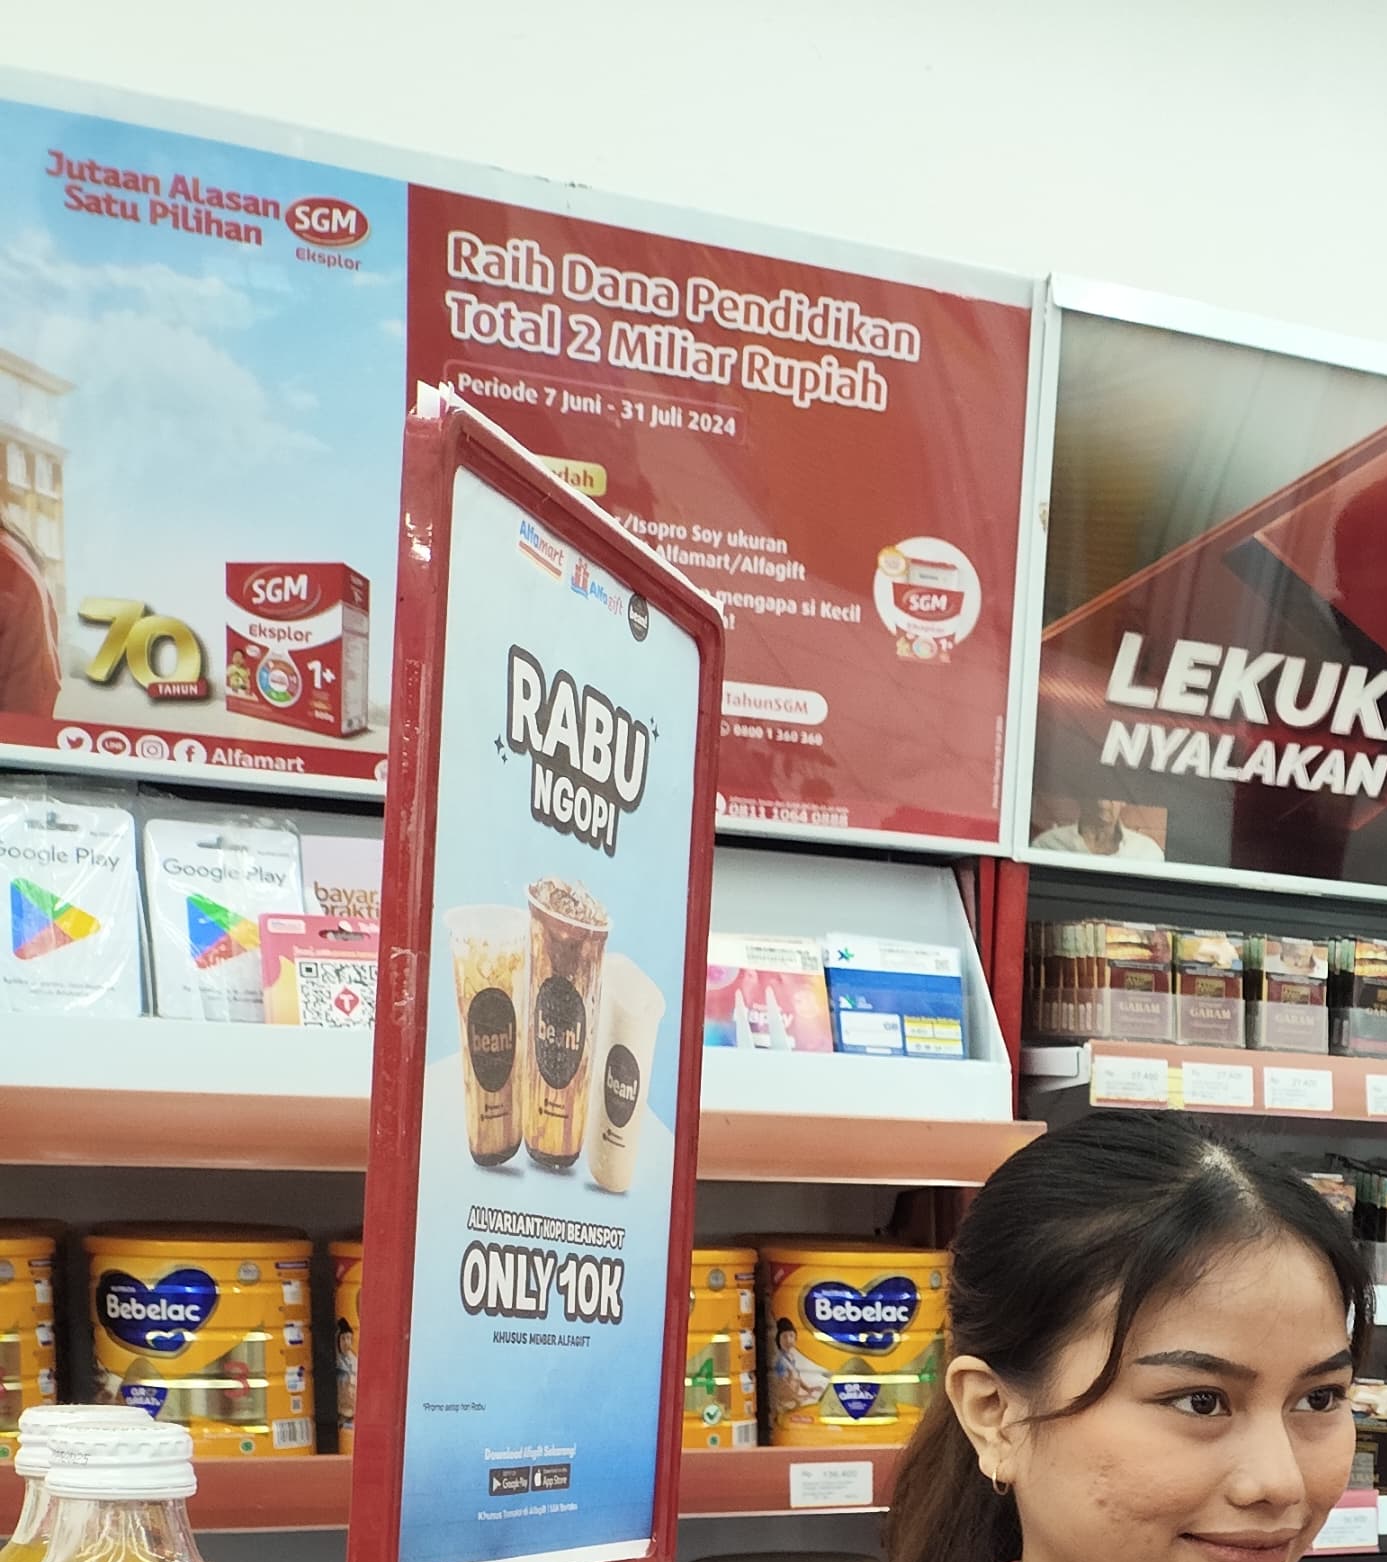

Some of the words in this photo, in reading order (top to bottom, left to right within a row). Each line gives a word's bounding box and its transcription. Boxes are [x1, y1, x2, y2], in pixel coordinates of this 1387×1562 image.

[46, 150, 160, 196] Jutaan
[168, 174, 280, 220] Alasan
[64, 185, 140, 222] Satu
[149, 199, 263, 246] Pilihan
[293, 205, 358, 234] SGM
[295, 247, 362, 271] Eksplor
[446, 230, 554, 295] Raih
[562, 254, 679, 318] Dana
[686, 277, 920, 361] Pendidikan
[446, 292, 562, 354] Total
[566, 315, 601, 362] 2
[607, 321, 736, 385] Miliar
[741, 346, 887, 412] Rupiah
[458, 372, 538, 405] Periode
[543, 385, 556, 405] 7
[561, 389, 601, 415] Juni
[621, 400, 646, 424] 31
[650, 402, 683, 431] Juli
[687, 407, 736, 437] 2024
[692, 526, 722, 548] Soy
[728, 530, 788, 554] ukuran
[251, 574, 308, 605] SGM
[908, 594, 948, 612] SGM
[716, 590, 797, 616] mengapa
[820, 602, 861, 623] Kecil
[79, 599, 201, 690] 70
[248, 622, 312, 645] Eksplor
[158, 683, 199, 697] TAHUN
[508, 648, 649, 808] RABU
[210, 747, 306, 774] Alfamart
[532, 760, 618, 850] NGOPI
[75, 847, 120, 872] Play
[162, 857, 240, 883] Google
[472, 1023, 513, 1053] bean!
[607, 1068, 637, 1101] bean!
[486, 1208, 543, 1238] VARIANT
[543, 1218, 566, 1243] KOPI
[567, 1220, 625, 1249] BEANSPOT
[461, 1242, 556, 1318] ONLY
[557, 1255, 625, 1322] 10K
[106, 1293, 201, 1323] Bebelac
[814, 1298, 909, 1322] Bebelac
[493, 1331, 527, 1346] KHUSUS
[529, 1333, 556, 1346] MEMBER
